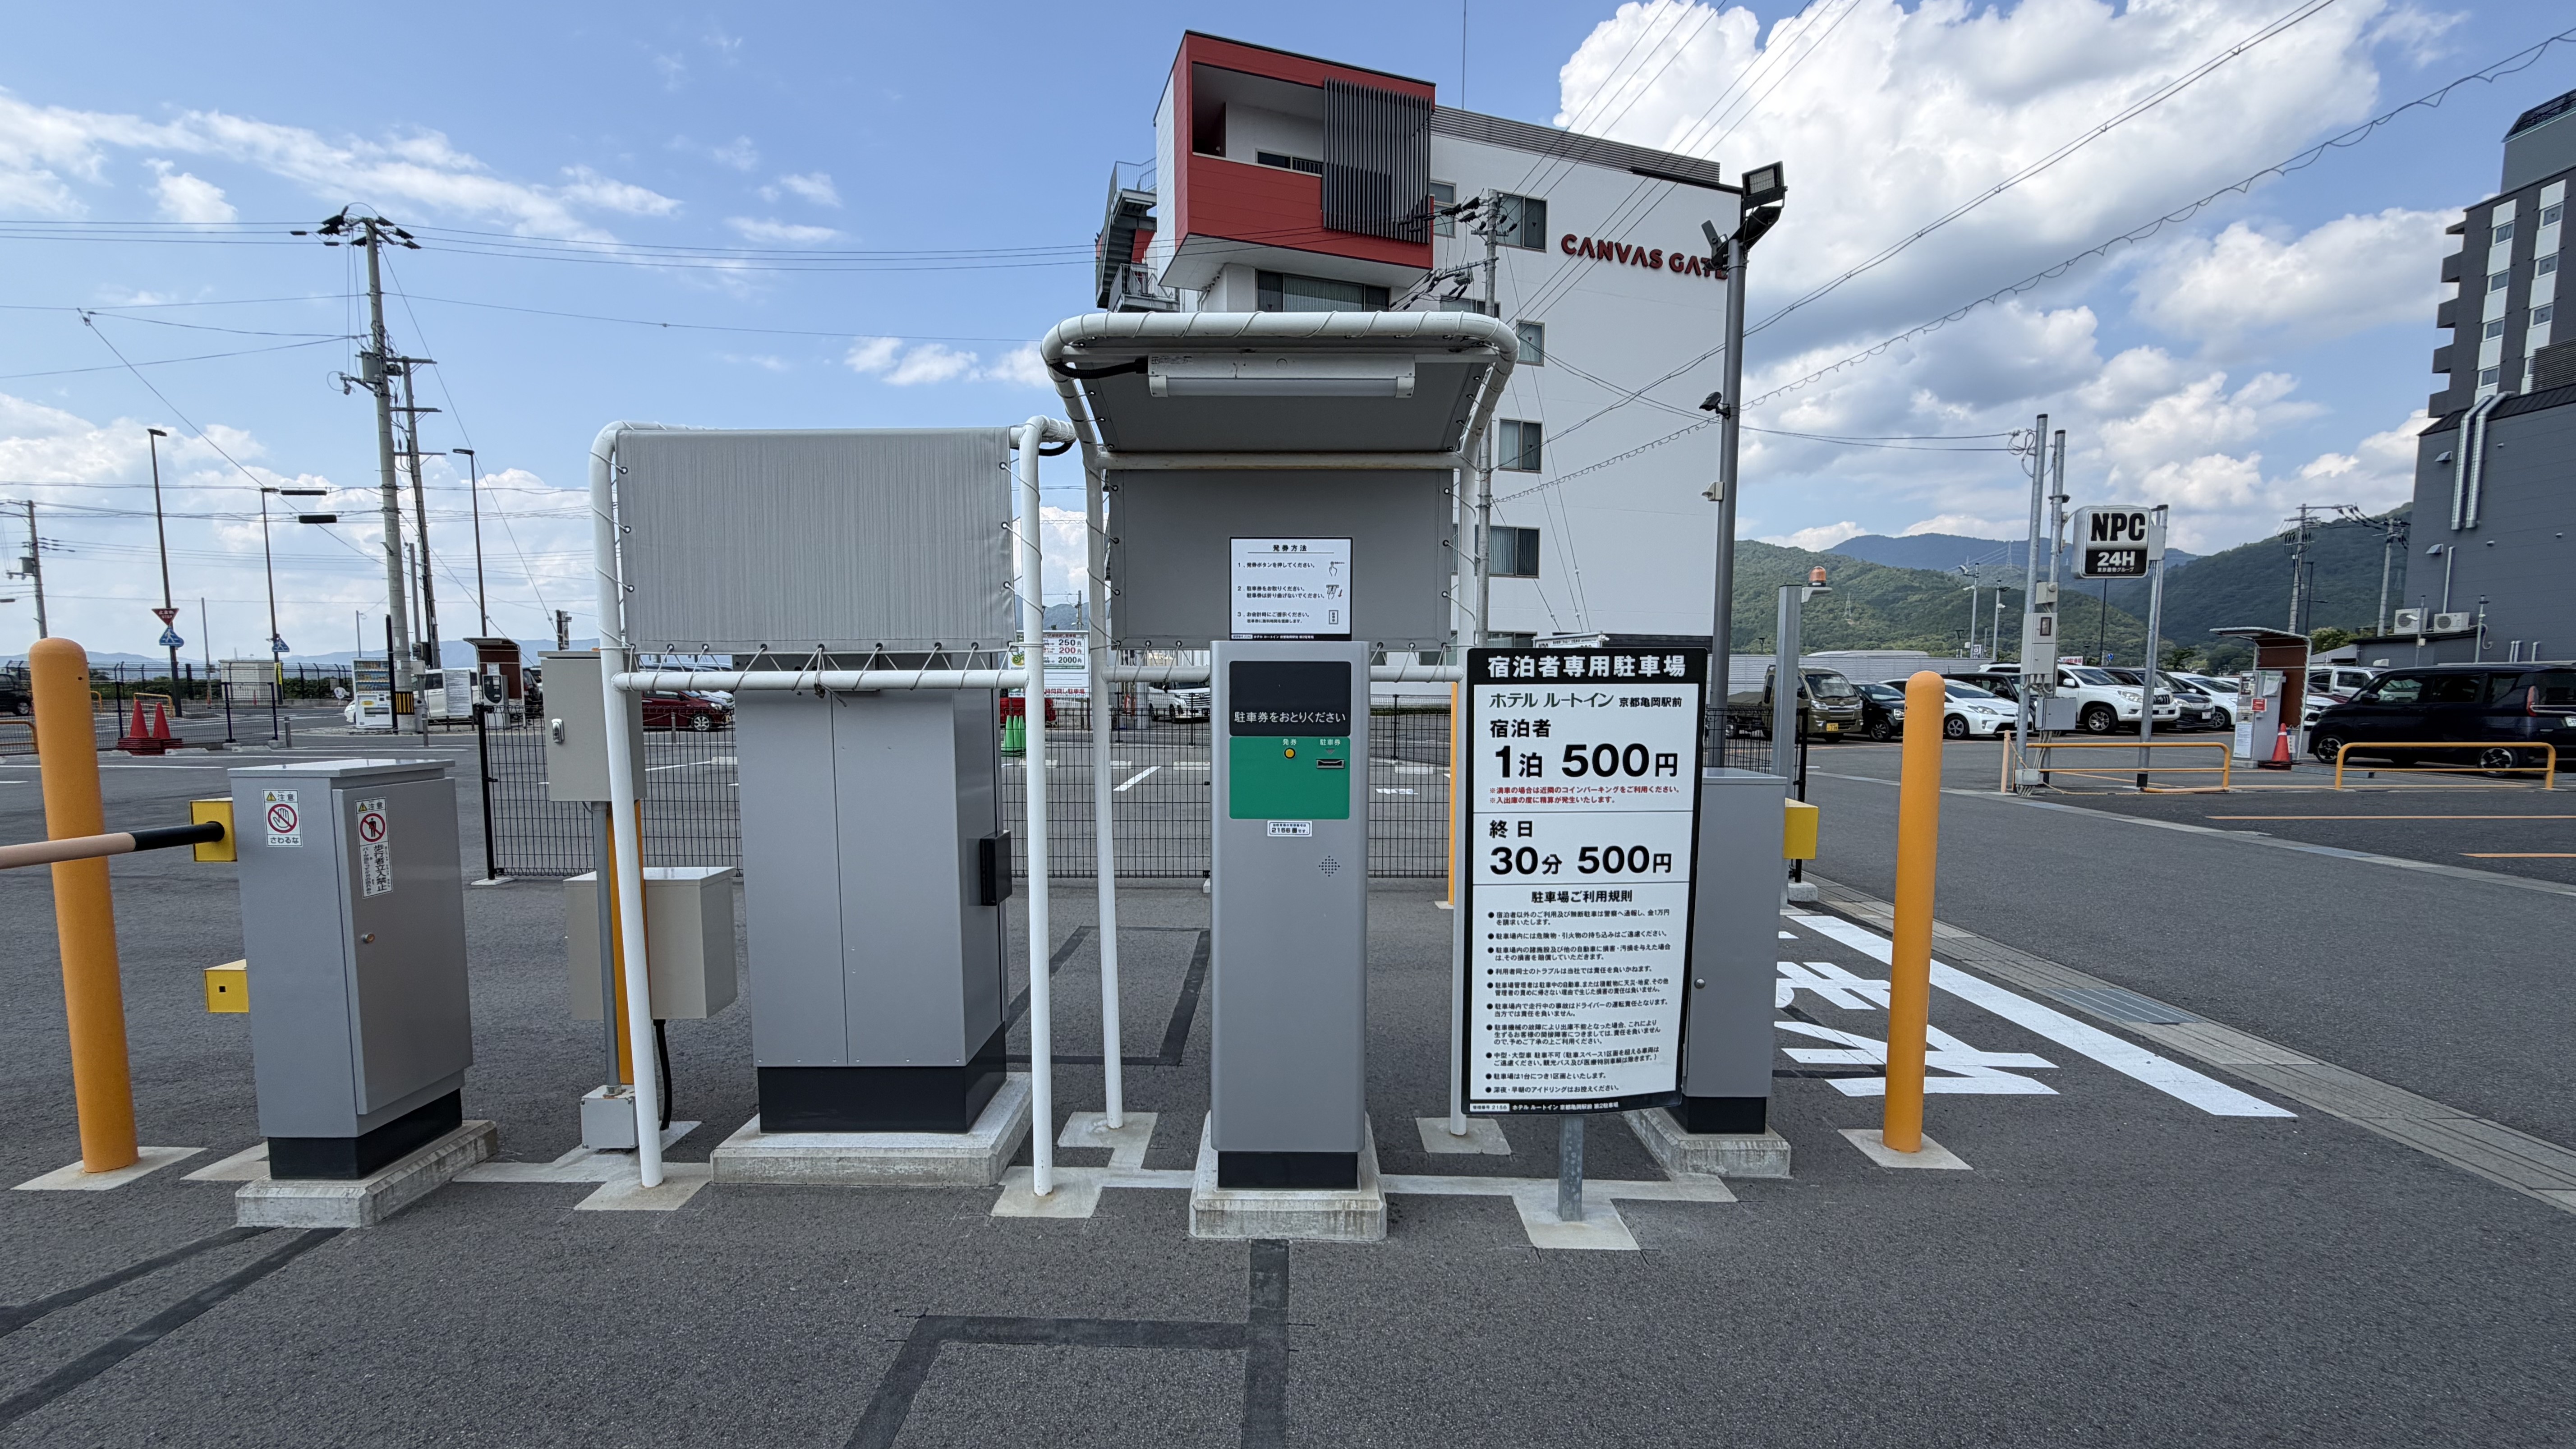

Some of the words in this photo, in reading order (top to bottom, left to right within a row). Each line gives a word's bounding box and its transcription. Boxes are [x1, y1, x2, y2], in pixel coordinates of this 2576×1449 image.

[1561, 234, 1663, 269] CANVAS
[2091, 513, 2145, 541] NPC
[2097, 551, 2135, 566] 24H
[1487, 655, 1686, 678] 宿泊者専用駐車場
[1489, 692, 1538, 708] ホテル
[1544, 692, 1614, 708] ルートイン
[1619, 697, 1682, 708] 京都亀岡駅前
[1234, 712, 1346, 723] 駐車券をおとりください
[1490, 719, 1551, 738] 宿泊者
[1495, 745, 1542, 778] 1泊
[1561, 743, 1678, 778] 500円
[368, 801, 383, 810] 注意
[373, 844, 387, 892] 歩行者立入禁止
[1490, 845, 1563, 875] 30分
[1577, 845, 1673, 874] 500円
[1531, 889, 1633, 903] 駐車場ご利用規則
